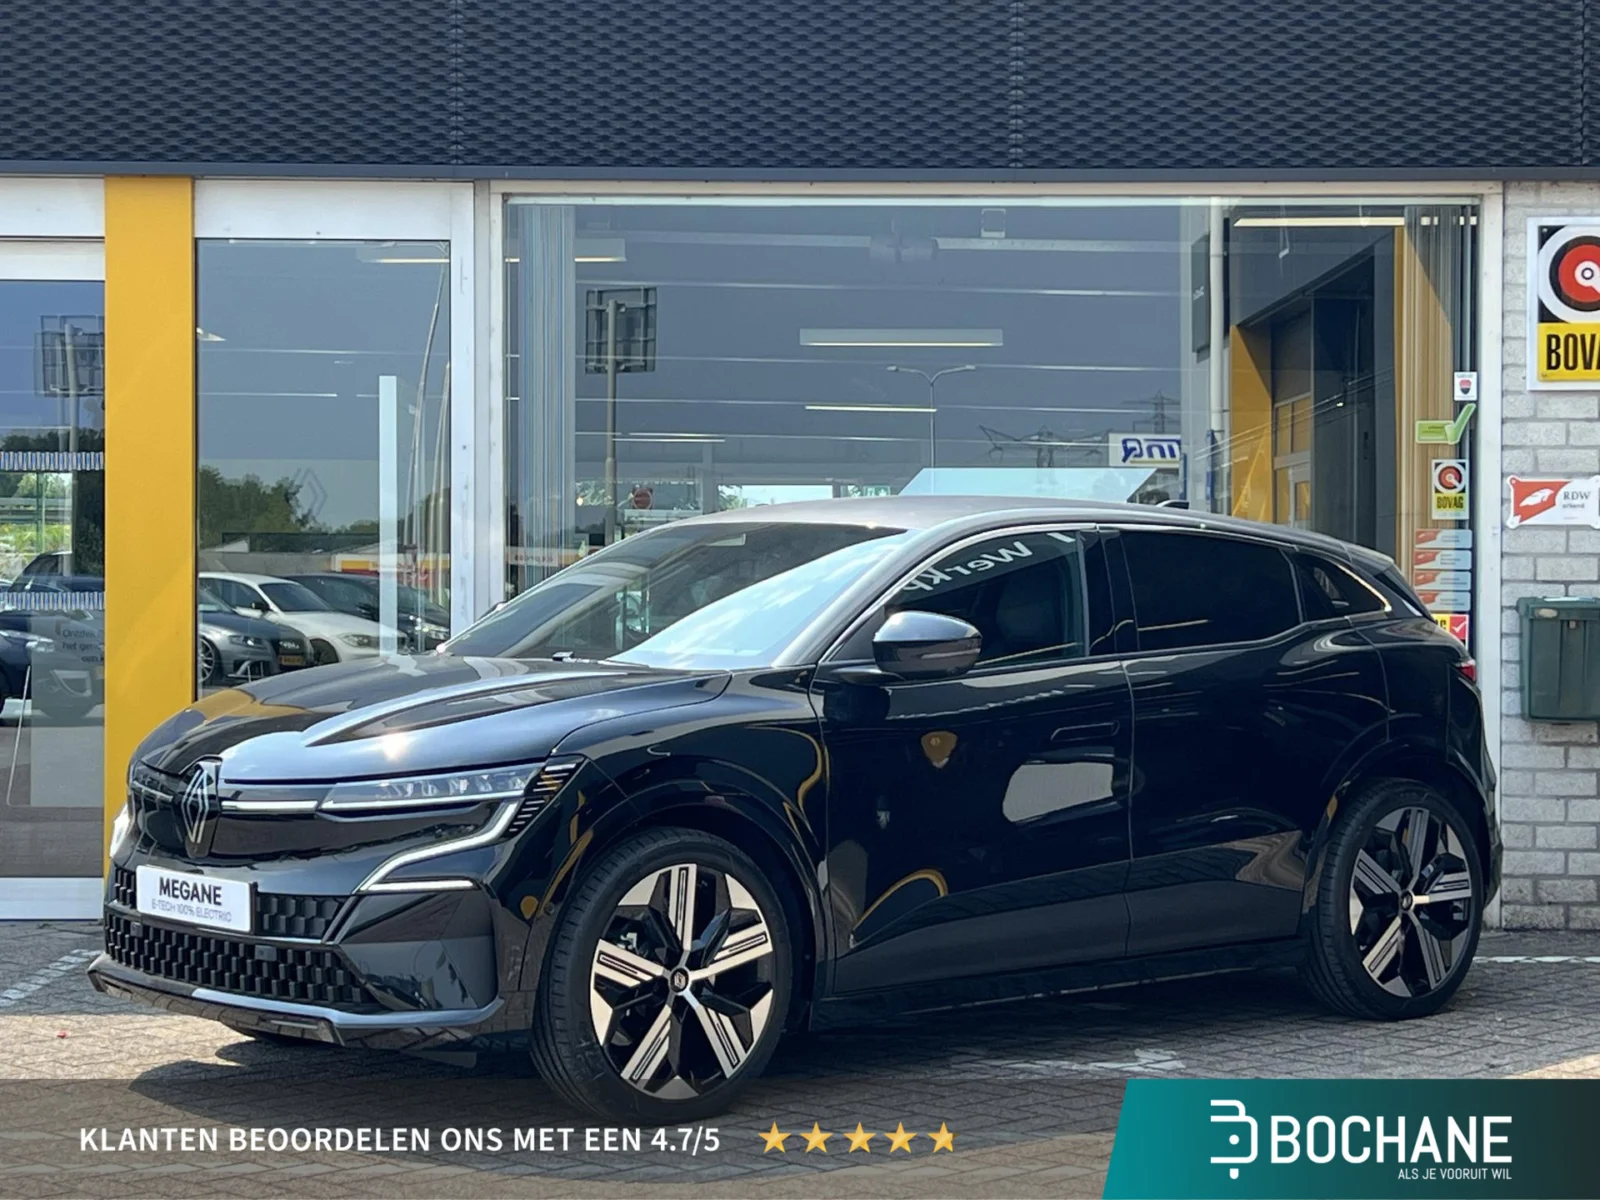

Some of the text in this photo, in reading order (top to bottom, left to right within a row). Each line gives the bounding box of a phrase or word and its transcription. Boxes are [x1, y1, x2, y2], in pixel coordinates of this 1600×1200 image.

[1436, 496, 1464, 509] BOVAG
[1563, 491, 1592, 501] RDW
[159, 877, 222, 906] MEGANE
[151, 898, 232, 922] E-TECH 100% ELECTRIC
